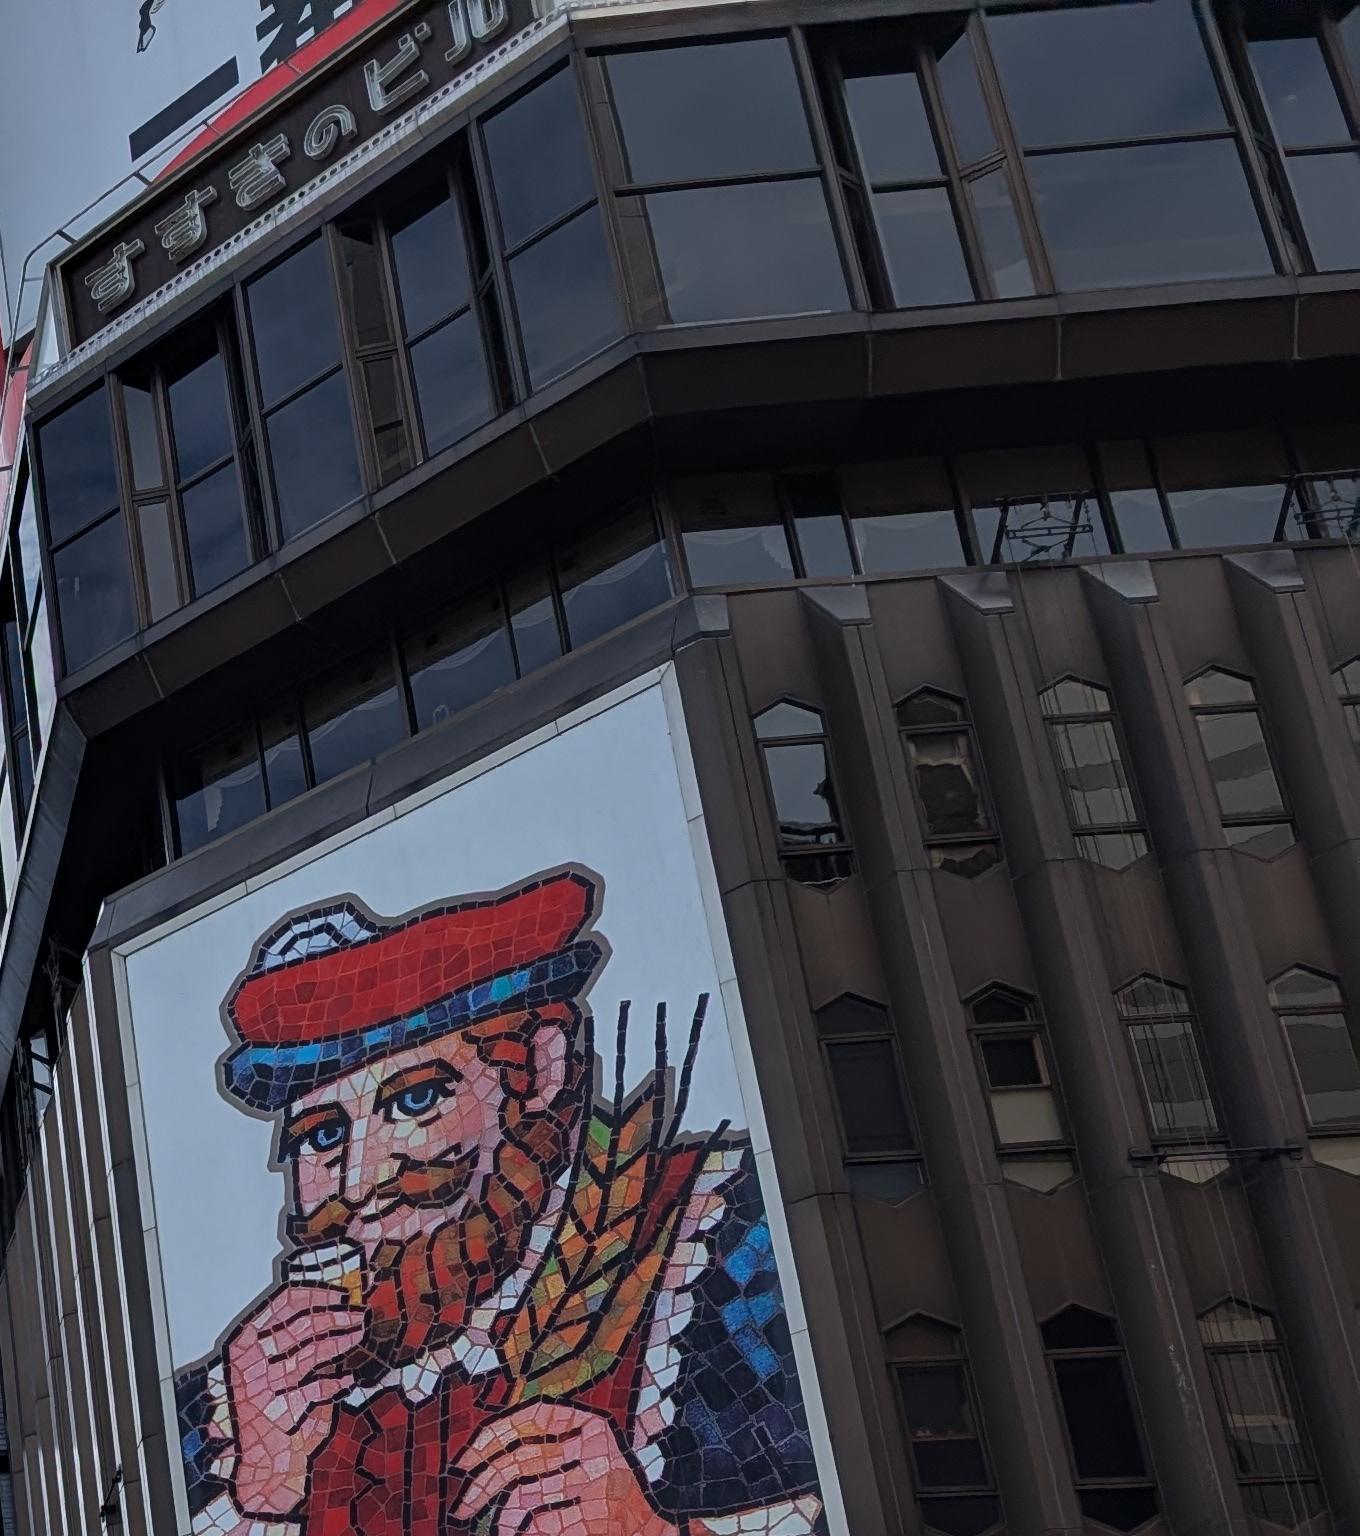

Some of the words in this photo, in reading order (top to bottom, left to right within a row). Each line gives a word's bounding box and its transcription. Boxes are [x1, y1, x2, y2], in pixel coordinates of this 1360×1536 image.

[85, 0, 511, 312] すすきのビル
